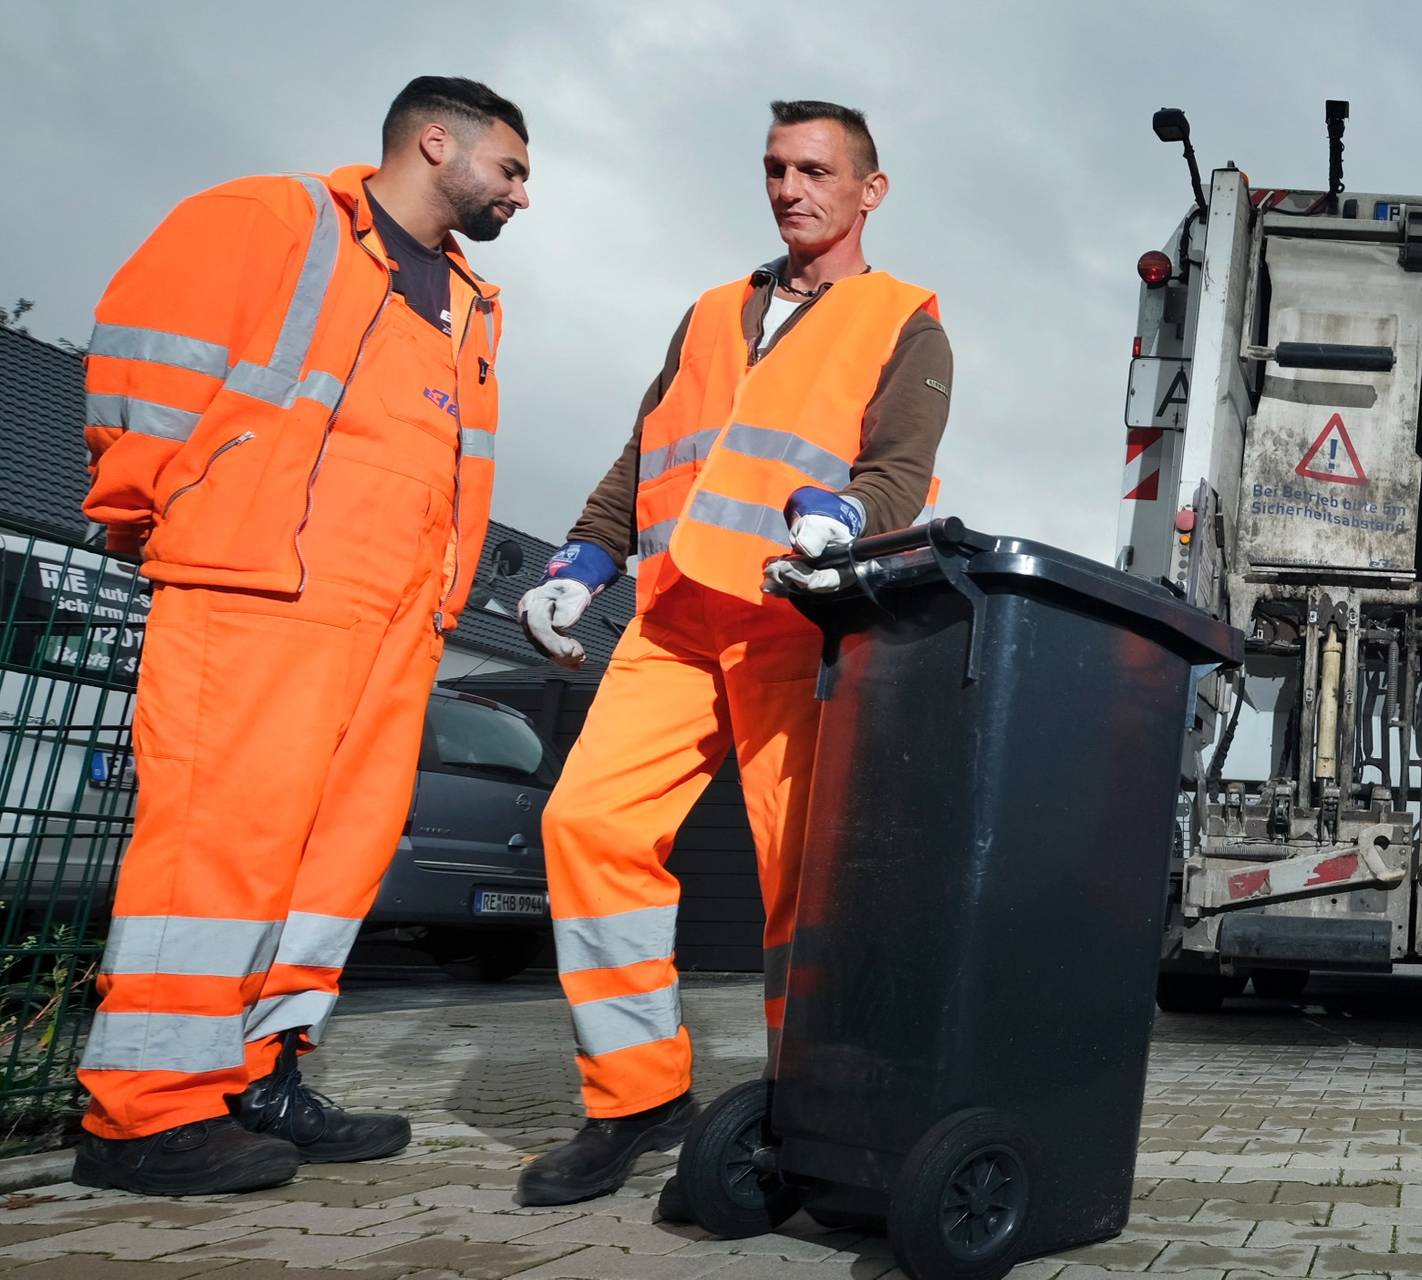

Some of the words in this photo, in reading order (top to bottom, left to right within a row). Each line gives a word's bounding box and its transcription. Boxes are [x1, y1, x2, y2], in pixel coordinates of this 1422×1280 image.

[1156, 370, 1189, 417] A
[1252, 484, 1278, 498] Bei
[1283, 485, 1338, 508] Betrieb
[1251, 501, 1406, 533] Sicherheitsabstand
[483, 894, 497, 911] RE
[502, 895, 516, 911] HB
[519, 896, 542, 912] 9944
